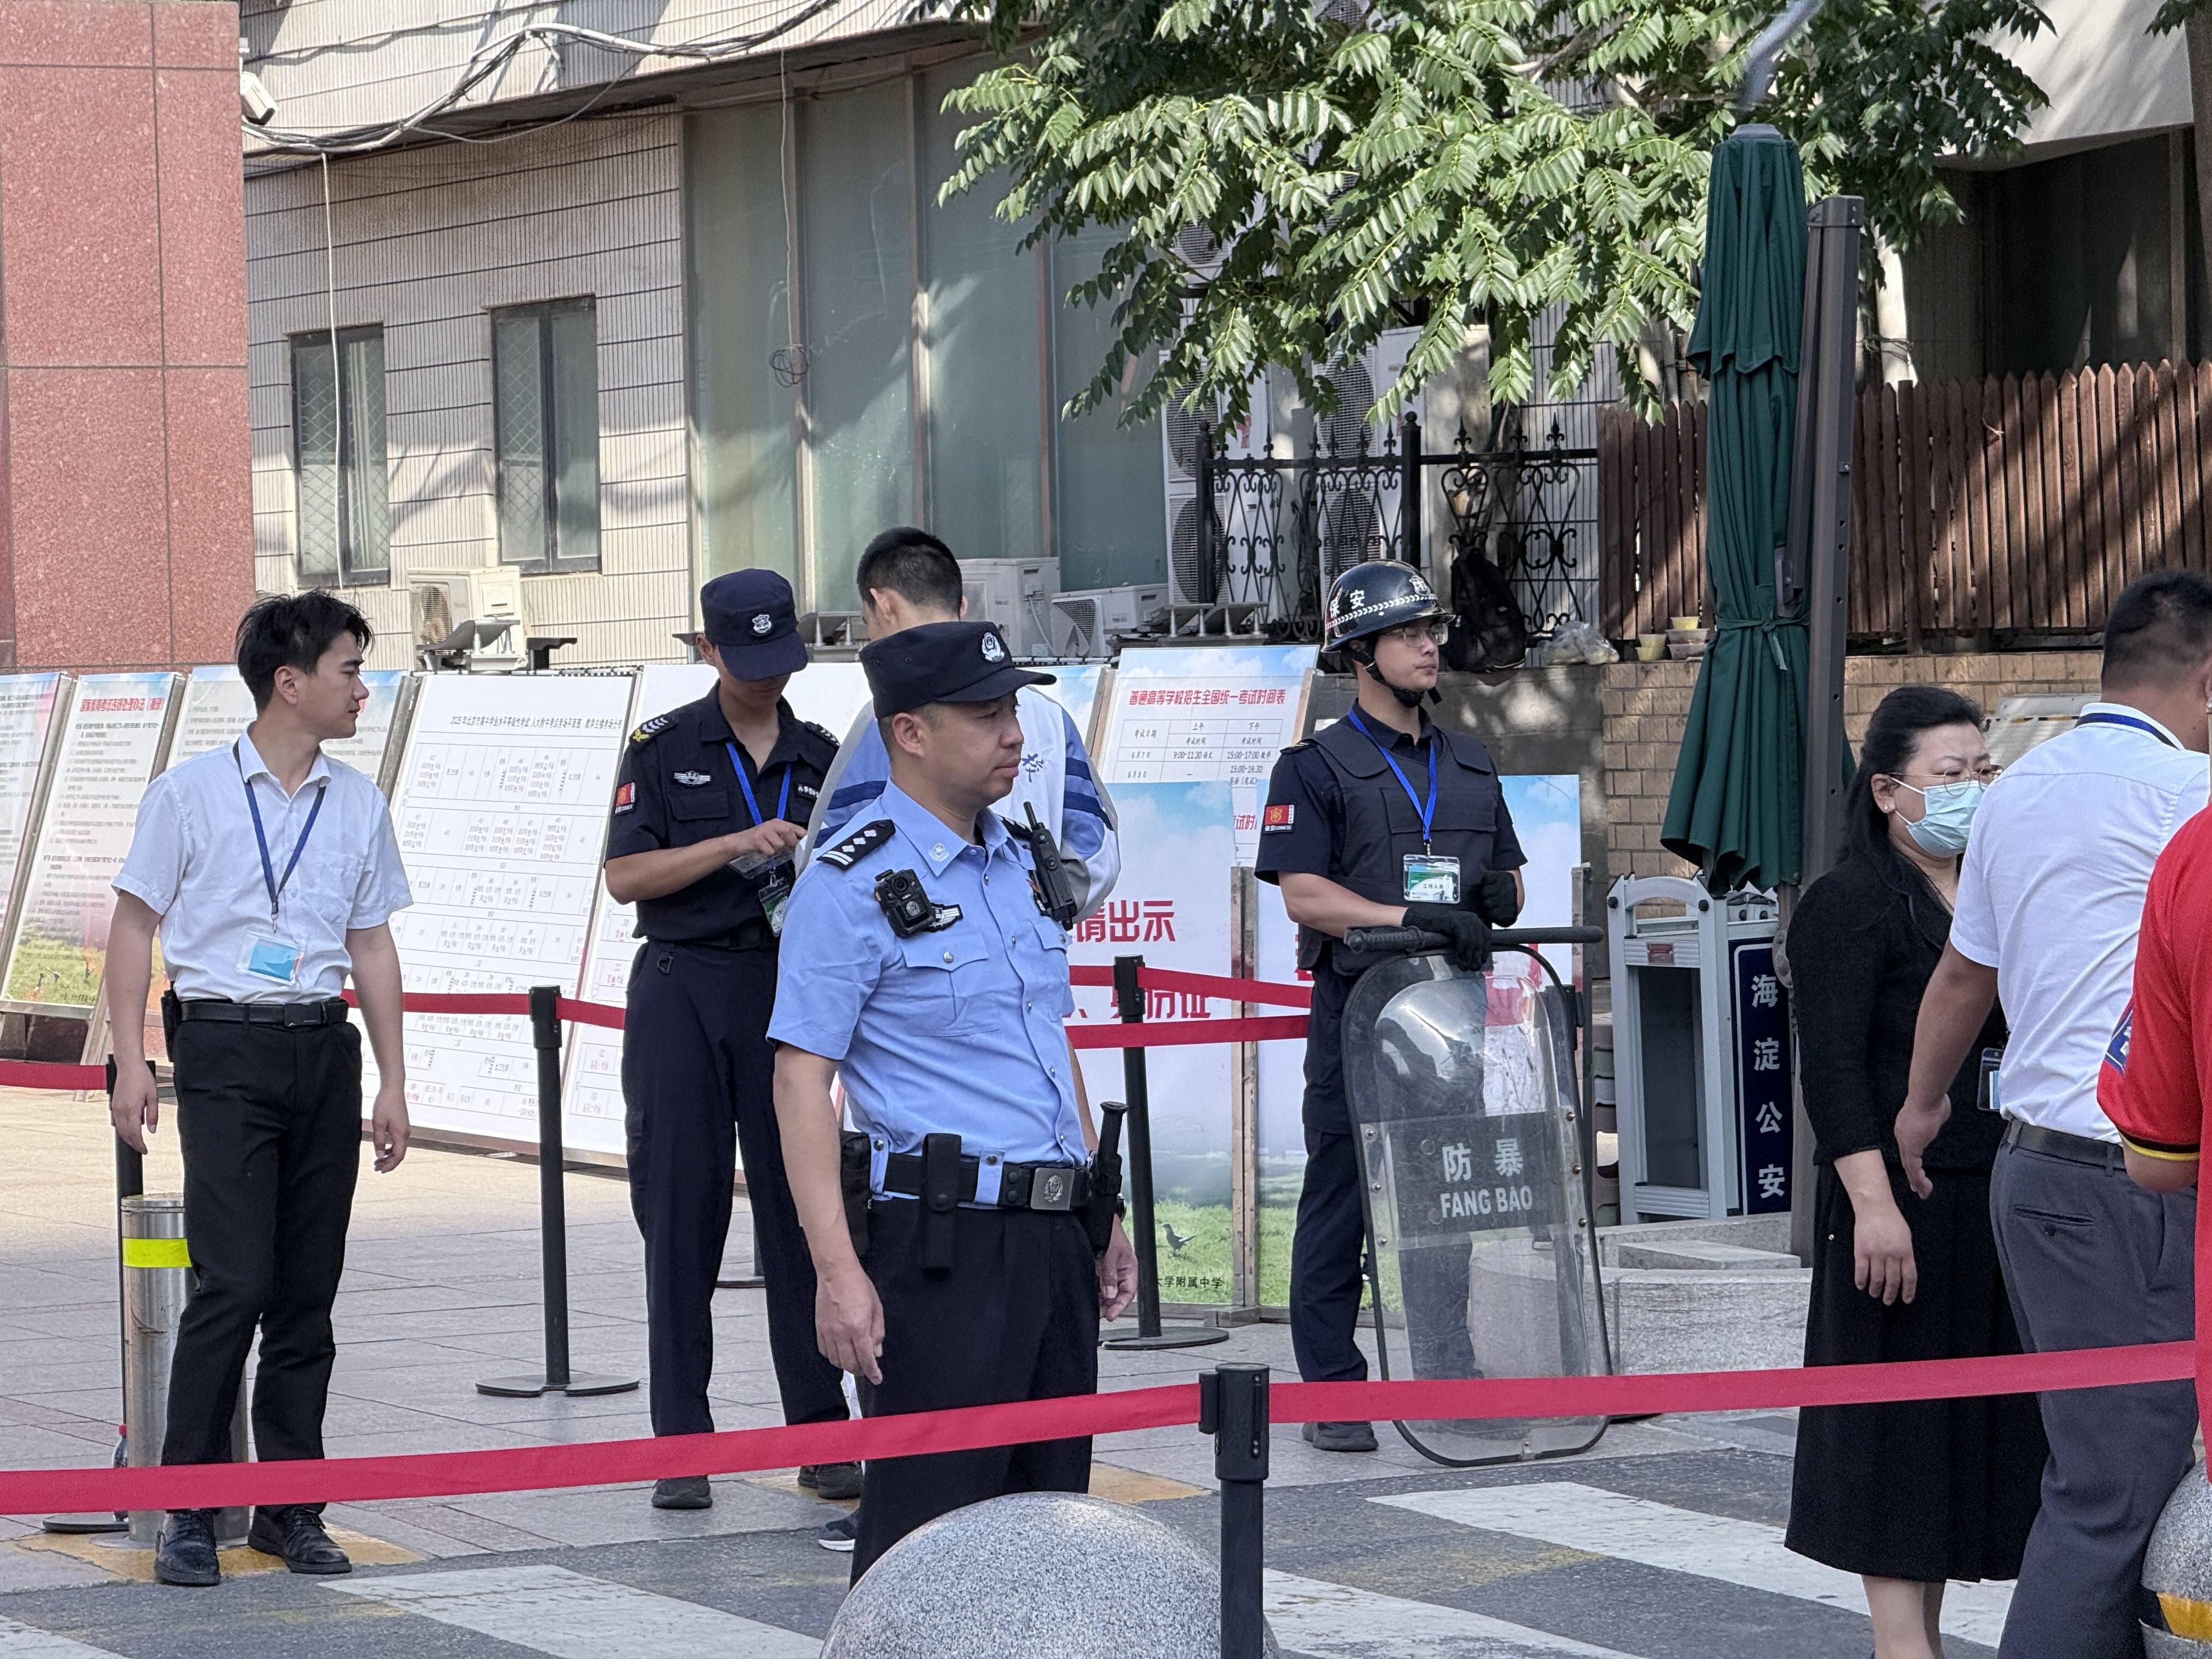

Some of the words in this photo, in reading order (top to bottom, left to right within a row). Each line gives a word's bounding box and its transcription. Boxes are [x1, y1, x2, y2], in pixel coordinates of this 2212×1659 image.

[1329, 589, 1365, 619] 保安
[1129, 689, 1286, 706] 普通高等学校招生全国统一考试时间表
[1192, 722, 1205, 732] 上午
[1248, 722, 1260, 732] 下午
[1751, 974, 1786, 1199] 海淀公安
[1442, 1138, 1524, 1183] 防暴
[1440, 1189, 1492, 1219] FANG
[1495, 1184, 1533, 1212] BAO
